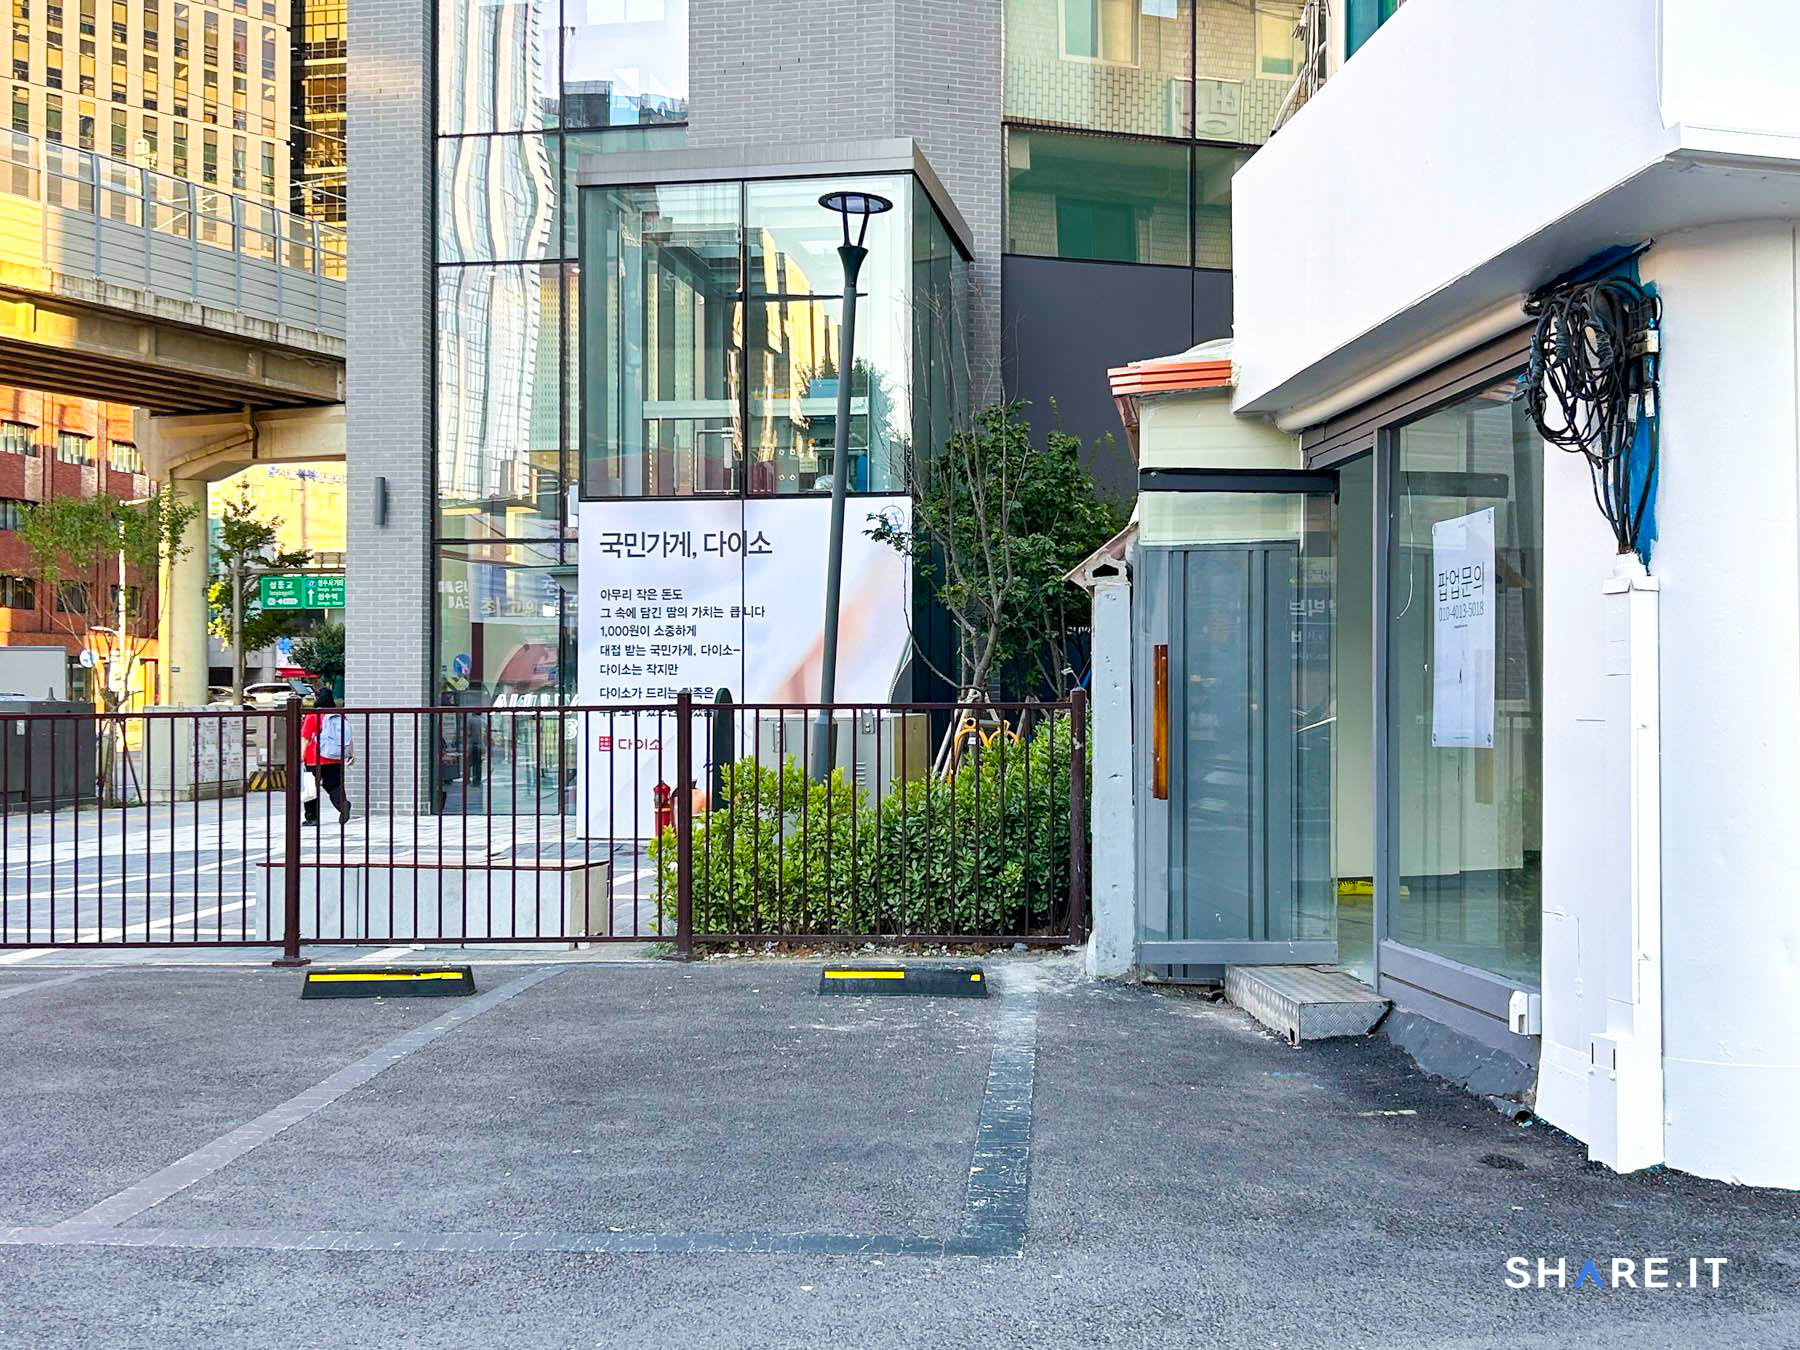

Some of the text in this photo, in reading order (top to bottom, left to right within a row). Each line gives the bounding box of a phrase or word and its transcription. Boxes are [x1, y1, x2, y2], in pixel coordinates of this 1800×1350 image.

[600, 530, 773, 559] 국민가게, 다이소
[1438, 562, 1485, 602] 팝업문의
[600, 589, 683, 601] 아무리 작은 돈도
[601, 606, 765, 619] 그 속에 담긴 땀의 가치는 큽니다
[600, 625, 697, 637] 1,000원이 소중하게
[600, 644, 621, 657] 대접
[625, 645, 647, 656] 받는
[600, 664, 679, 675] 다이소는 작지만
[600, 687, 642, 699] 다이소가
[646, 687, 678, 699] 드리는
[618, 739, 663, 750] 다이소
